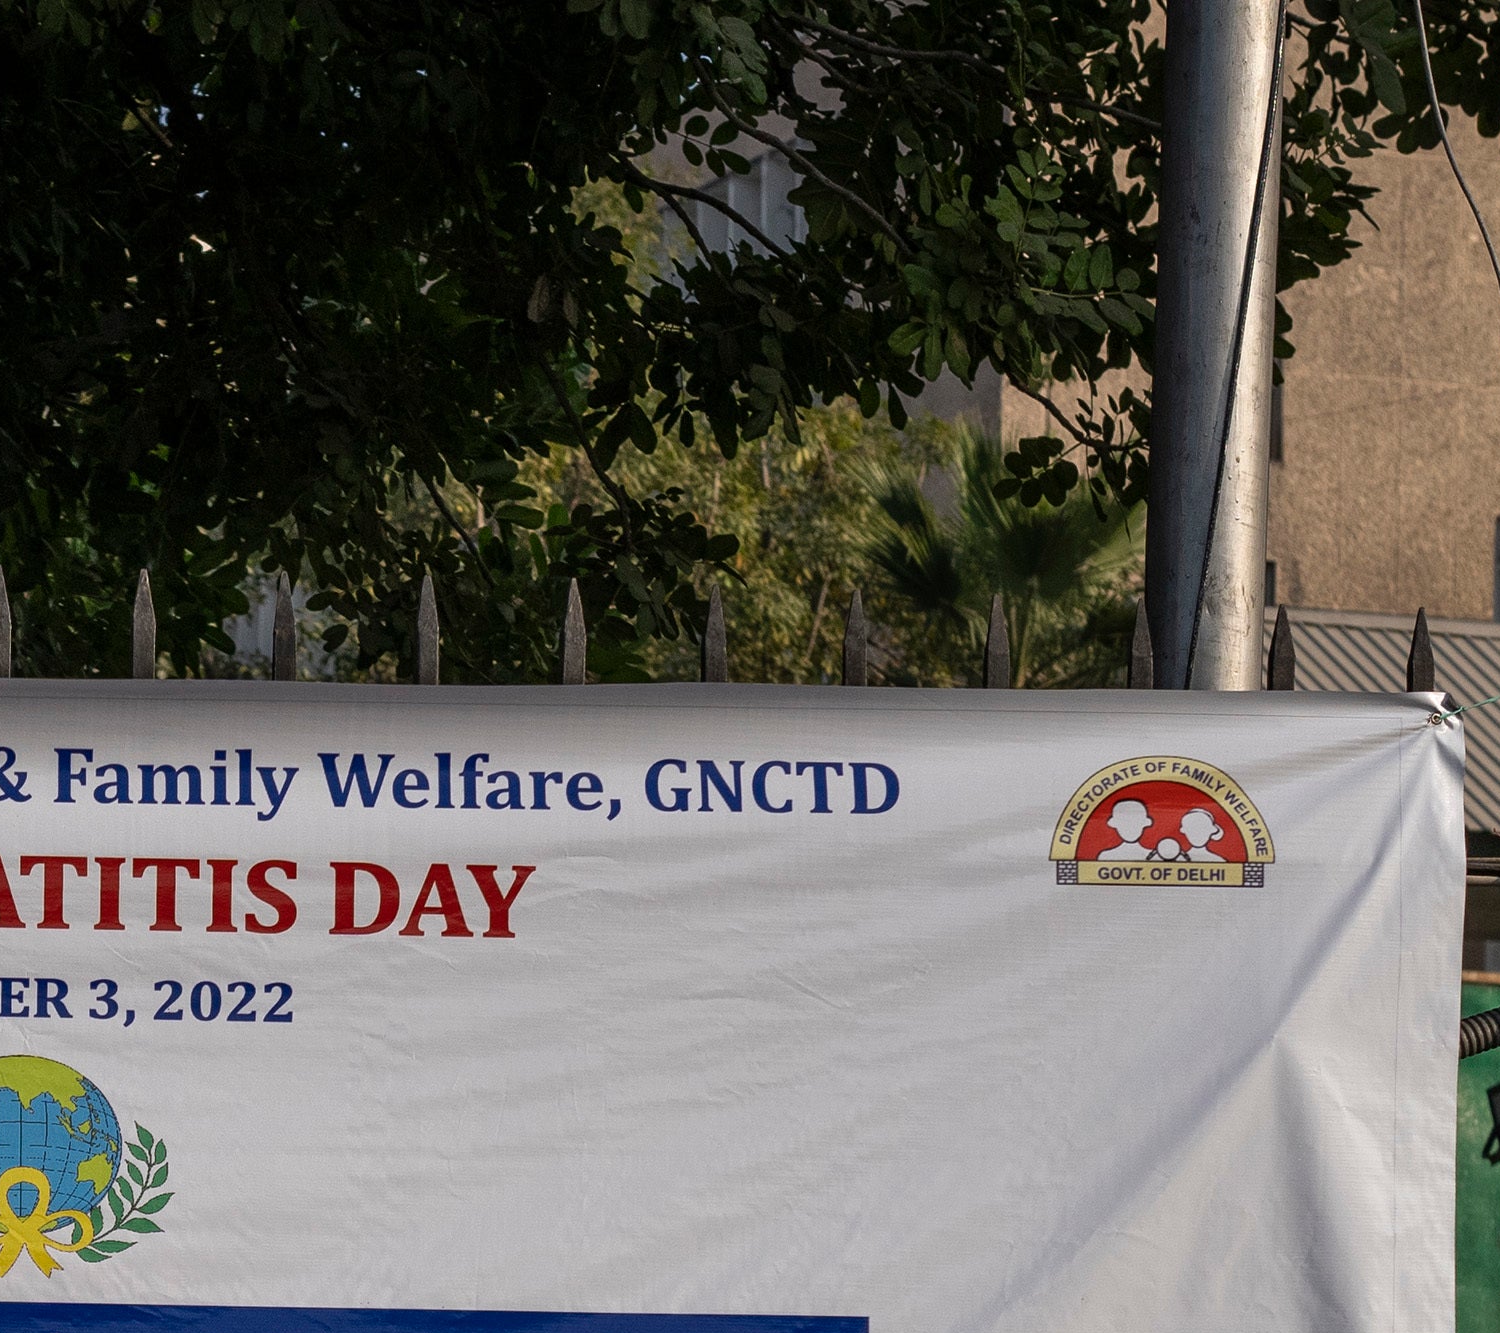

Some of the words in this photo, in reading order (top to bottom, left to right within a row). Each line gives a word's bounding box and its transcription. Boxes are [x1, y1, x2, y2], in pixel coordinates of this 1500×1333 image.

[54, 748, 298, 821] Family
[317, 756, 622, 820] Welfare,
[646, 759, 900, 815] GNCTD
[1059, 764, 1140, 845] DIRECTORATE
[1145, 761, 1167, 774] OF
[1172, 762, 1225, 792] FAMILY
[1224, 790, 1269, 857] WELFARE
[330, 862, 537, 939] DAY
[1098, 867, 1146, 881] GOVT.
[1150, 868, 1172, 880] OF
[1176, 868, 1226, 882] DELHI
[90, 980, 137, 1026] 3,
[156, 981, 295, 1024] 2022
